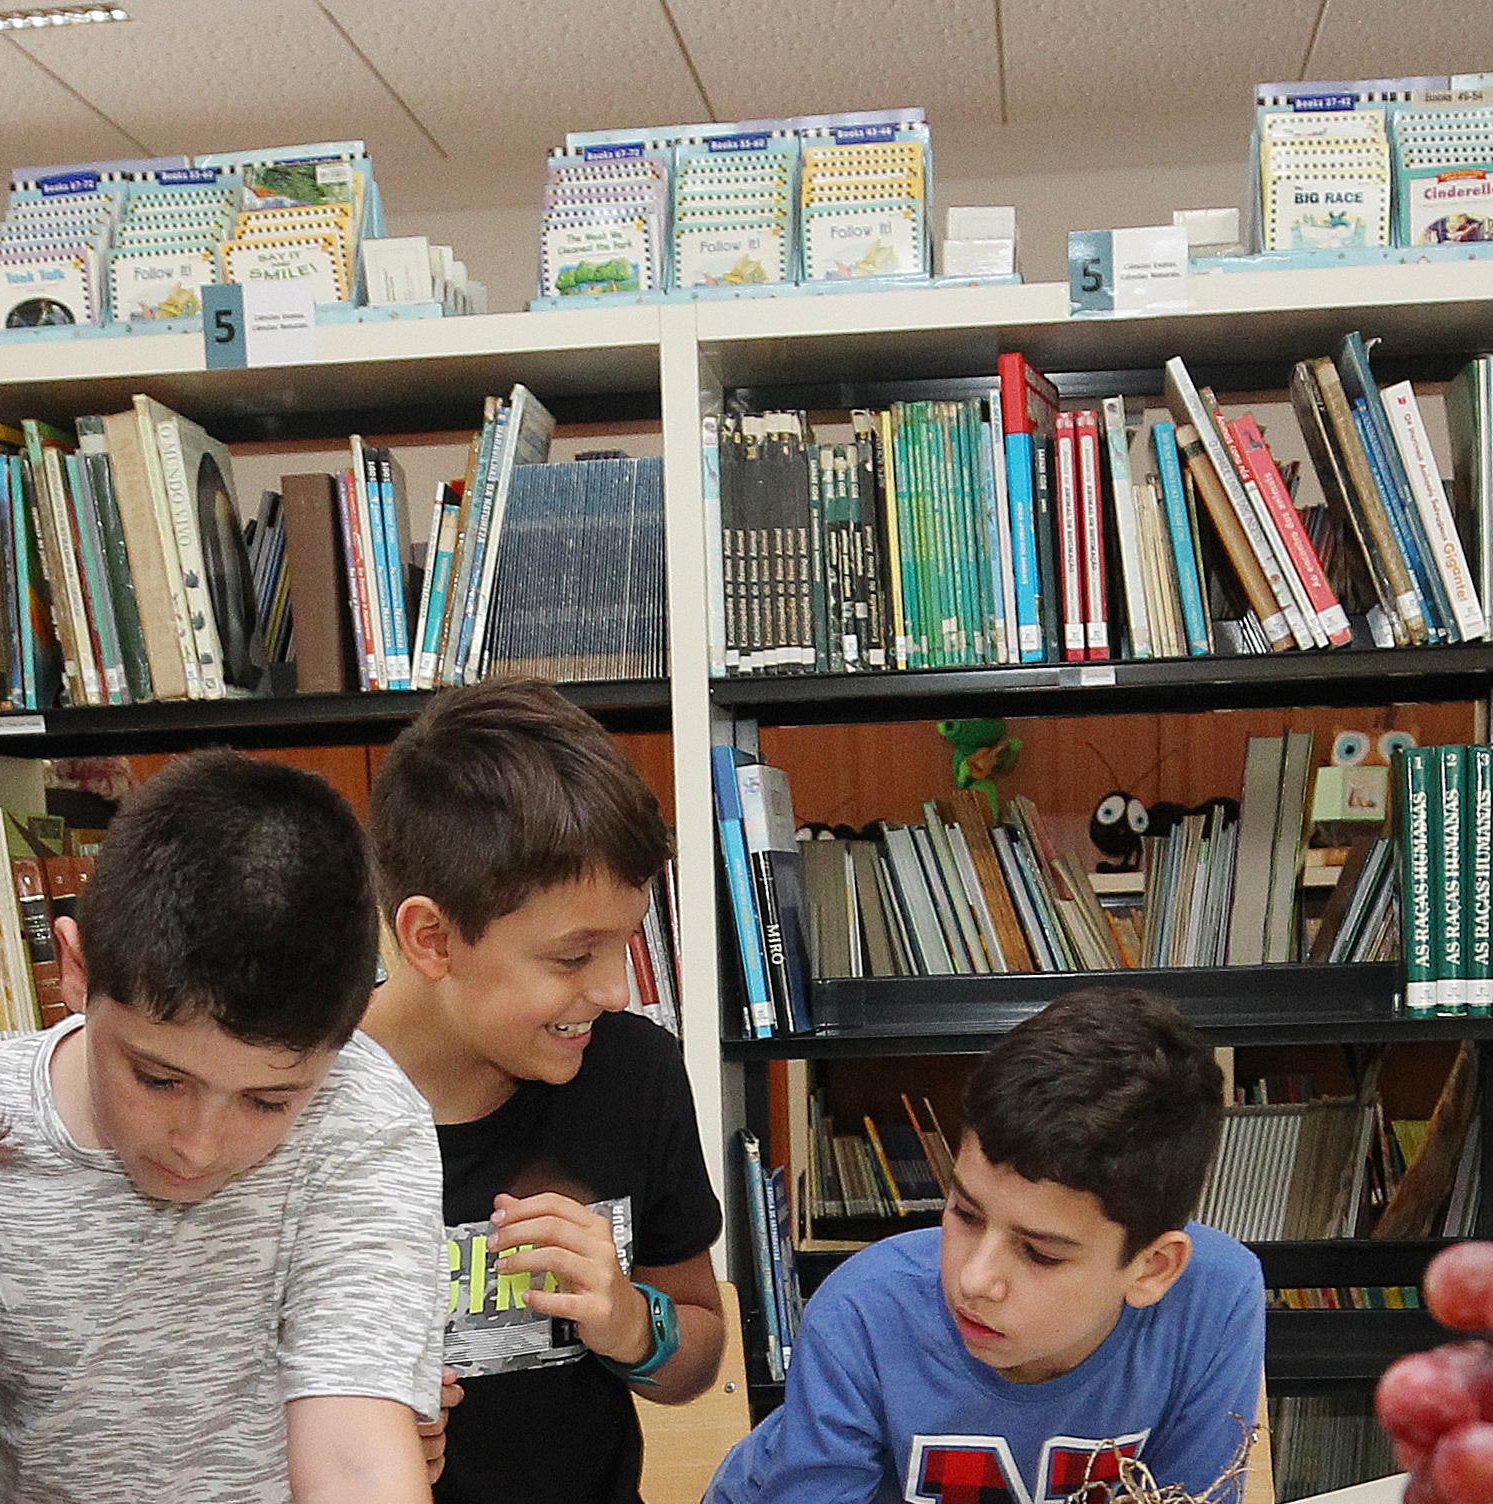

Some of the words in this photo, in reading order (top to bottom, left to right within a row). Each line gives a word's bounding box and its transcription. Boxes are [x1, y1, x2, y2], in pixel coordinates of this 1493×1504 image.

[1295, 192, 1319, 204] BIG
[1325, 191, 1364, 203] RACE
[830, 224, 871, 238] Follow
[258, 252, 286, 262] SAY
[700, 241, 741, 253] Follow
[134, 265, 173, 280] Follow
[249, 262, 317, 280] SMILE!
[1082, 258, 1103, 292] 5
[215, 309, 235, 343] 5
[160, 426, 173, 438] O
[162, 442, 185, 504] MUNDO
[172, 509, 190, 546] VIVO
[477, 499, 492, 544] NATUREZA
[1414, 756, 1423, 769] 1
[1447, 753, 1457, 766] 2
[1480, 753, 1490, 766] 3
[1412, 791, 1428, 880] HUMANAS
[1444, 789, 1459, 877] HUMANAS
[1475, 789, 1491, 878] HUMANAS
[1414, 883, 1429, 941] RAÇAS
[1445, 880, 1460, 938] RAÇAS
[1475, 880, 1491, 938] RAÇAS
[766, 923, 784, 965] MIRÓ
[1415, 944, 1430, 967] AS
[1446, 941, 1460, 965] AS
[1475, 941, 1490, 965] AS
